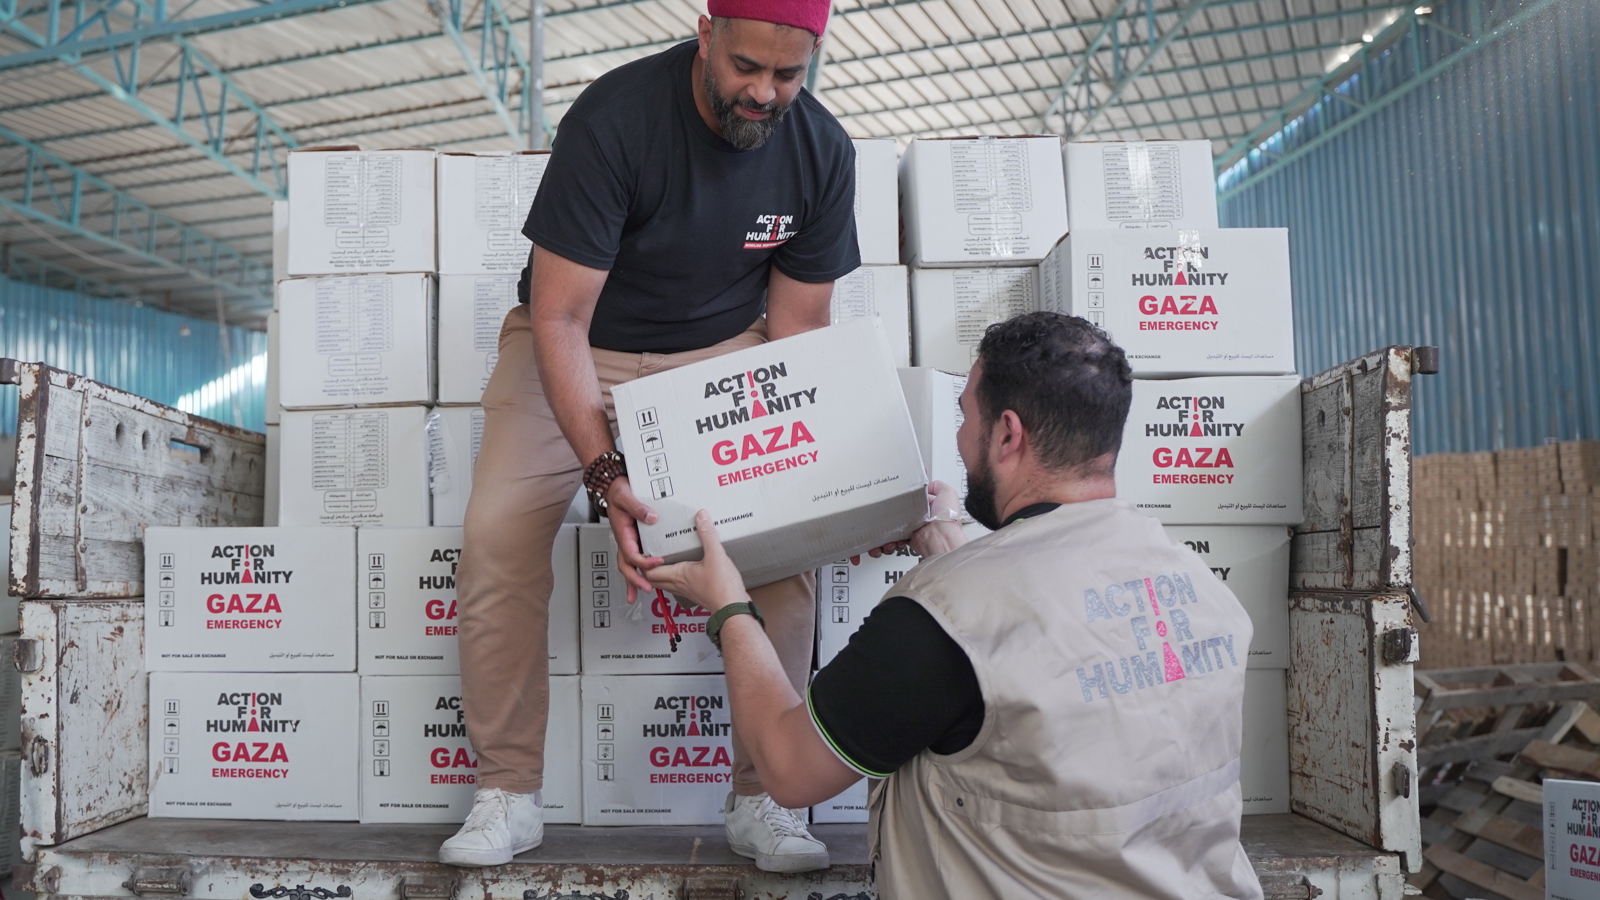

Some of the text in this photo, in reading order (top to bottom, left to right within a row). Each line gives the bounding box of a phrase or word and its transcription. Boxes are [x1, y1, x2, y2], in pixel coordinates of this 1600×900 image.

[756, 214, 794, 225] ACTION
[746, 231, 798, 241] HUMANITY
[766, 224, 786, 232] FOR
[1142, 246, 1208, 259] ACTN
[1132, 270, 1228, 286] HUMANITY
[1139, 295, 1218, 315] GAZA
[1140, 321, 1218, 330] EMERGENCY
[704, 361, 788, 400] ACTION
[732, 383, 778, 408] FOR
[696, 386, 818, 434] HUMANITY
[1156, 396, 1224, 412] ACTION
[1179, 410, 1214, 422] FOR
[1145, 422, 1244, 437] HUMANITY
[711, 420, 816, 466] GAZA
[1152, 447, 1234, 468] GAZA
[717, 450, 820, 487] EMERGENCY
[1153, 474, 1234, 484] EMERGENCY
[812, 475, 899, 502] مساعدات ليست للبيع أو التبديل
[720, 512, 753, 525] EXCHANGE
[211, 544, 275, 559] ACTION
[430, 549, 462, 562] ACT
[232, 558, 264, 572] FOR
[200, 568, 293, 585] HUMANITY
[206, 594, 282, 613] GAZA
[1084, 571, 1198, 623] ACTION
[425, 599, 458, 620] GA
[651, 597, 711, 618] GAZ
[206, 619, 282, 629] EMERGENCY
[1131, 608, 1195, 651] FOR
[1076, 634, 1239, 703] HUMANITY
[217, 692, 282, 708] ACTION
[654, 696, 723, 711] ACTION
[238, 706, 270, 719] FOR
[676, 710, 711, 723] FOR
[206, 717, 300, 733] HUMANITY
[643, 721, 731, 737] HUMANIT
[212, 742, 289, 762] GAZA
[430, 747, 477, 768] GA
[650, 746, 732, 767] GAZA
[212, 768, 289, 778] EMERGENCY
[430, 774, 477, 784] EMERG
[650, 774, 732, 783] EMERGENCY
[1581, 812, 1597, 825] FOR
[1567, 822, 1600, 838] HUMANI
[1570, 868, 1600, 882] EMERGEN
